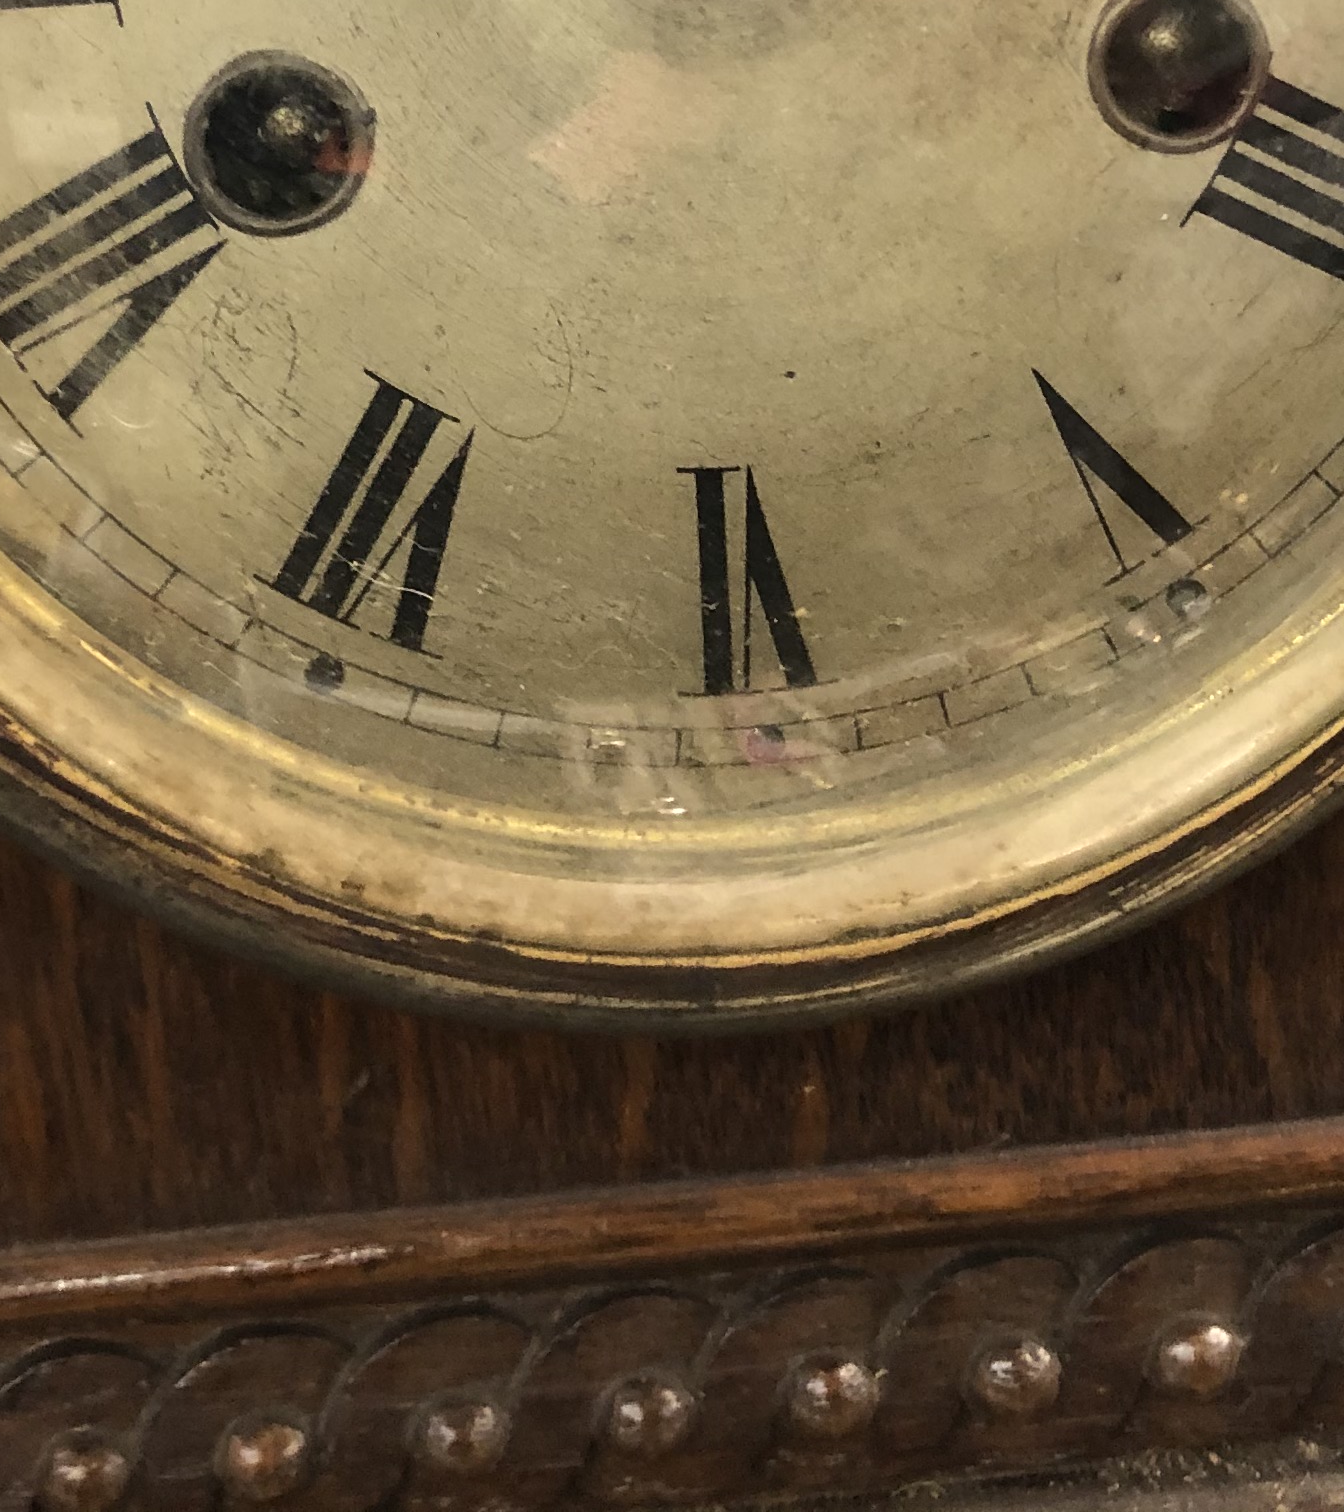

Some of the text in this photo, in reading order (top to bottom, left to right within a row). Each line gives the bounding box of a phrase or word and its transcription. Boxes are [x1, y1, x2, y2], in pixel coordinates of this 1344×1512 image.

[254, 368, 476, 659] VII
[676, 463, 836, 696] VI
[1031, 367, 1211, 586] V
